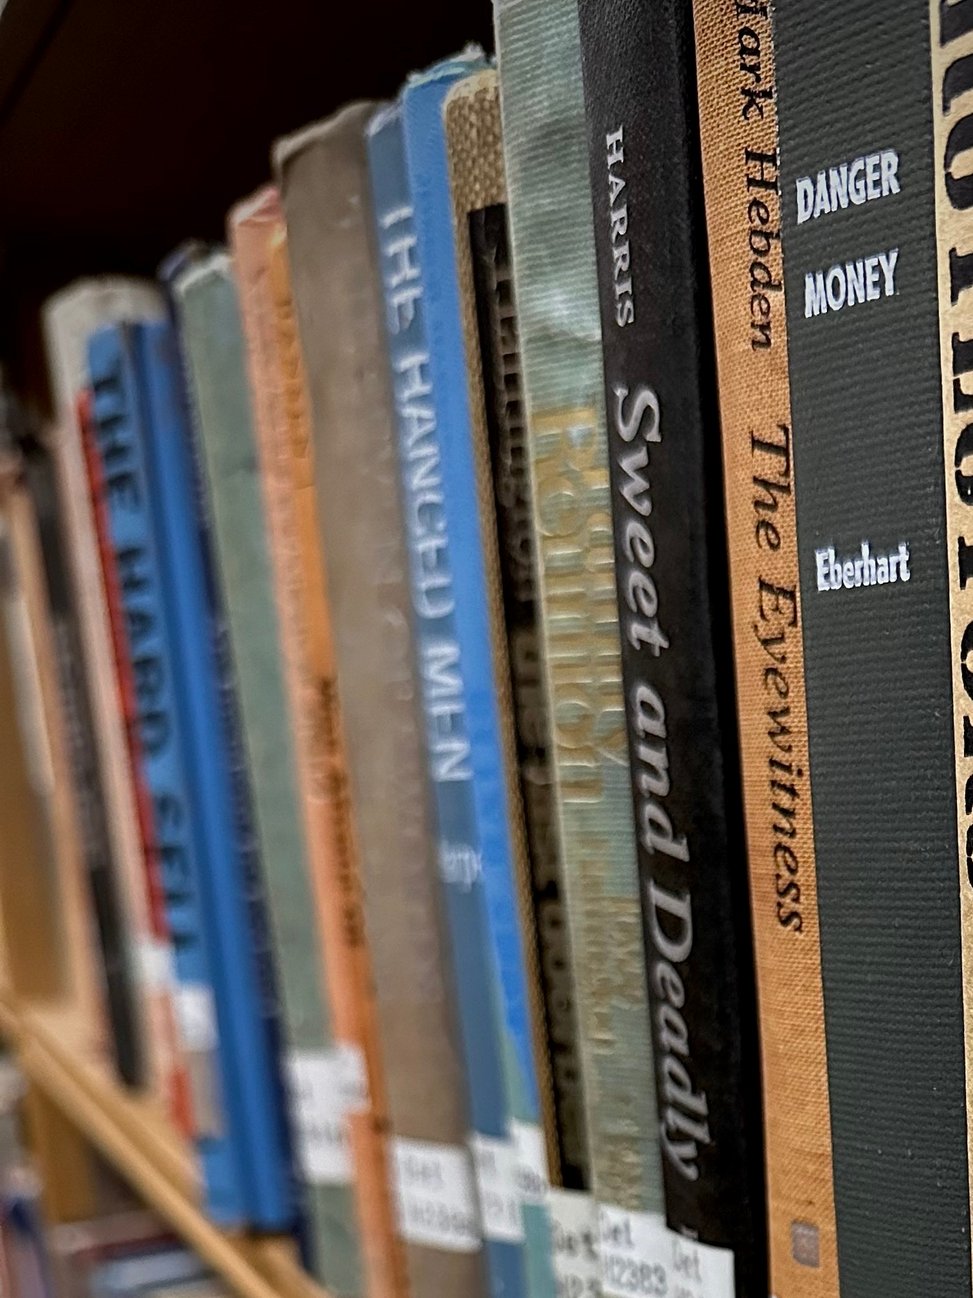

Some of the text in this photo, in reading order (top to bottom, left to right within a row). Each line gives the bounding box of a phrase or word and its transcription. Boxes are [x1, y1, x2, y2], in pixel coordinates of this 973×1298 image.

[605, 127, 635, 328] HARRIS
[735, 0, 785, 352] ark Hebden
[797, 149, 901, 224] DANGER
[803, 247, 900, 318] MONEY
[814, 540, 912, 592] Eberhart
[748, 424, 804, 934] The Eyewitness
[614, 384, 713, 1181] Sweet and Deadly
